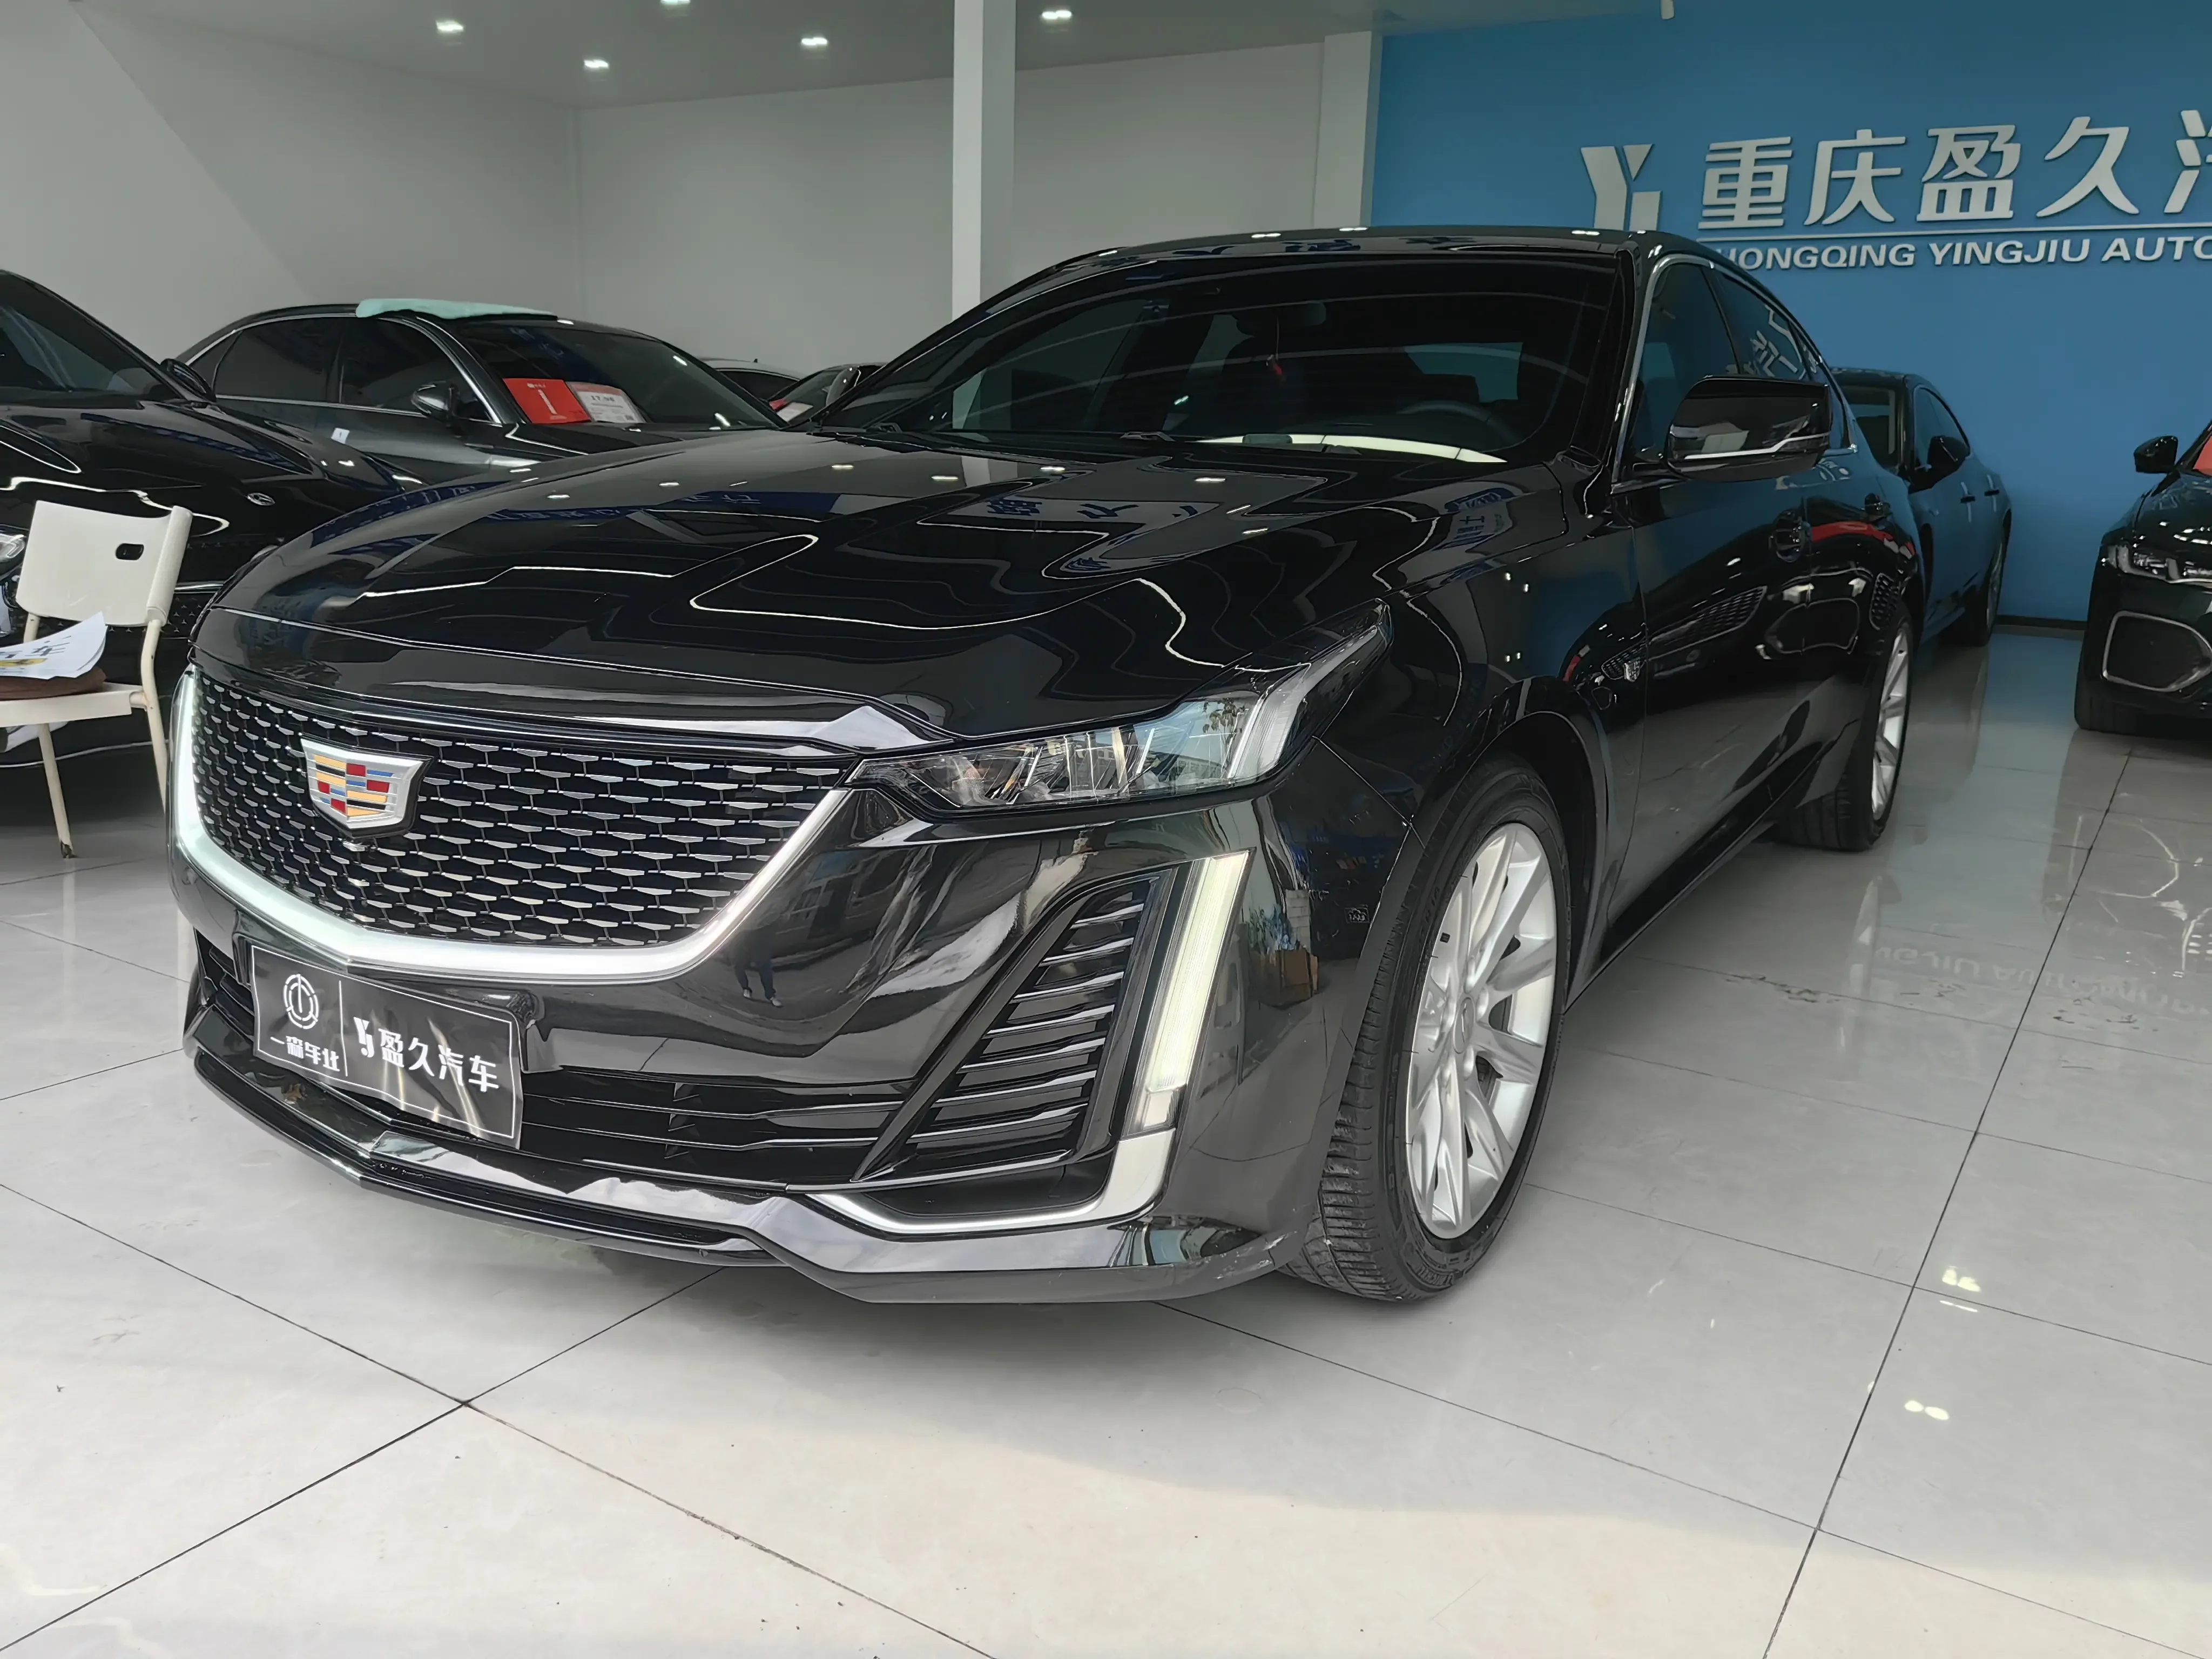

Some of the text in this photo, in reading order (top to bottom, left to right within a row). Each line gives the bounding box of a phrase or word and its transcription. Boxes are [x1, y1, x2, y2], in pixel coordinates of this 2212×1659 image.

[1928, 239, 2090, 265] YINGJIU
[379, 1028, 499, 1092] 盈久汽车
